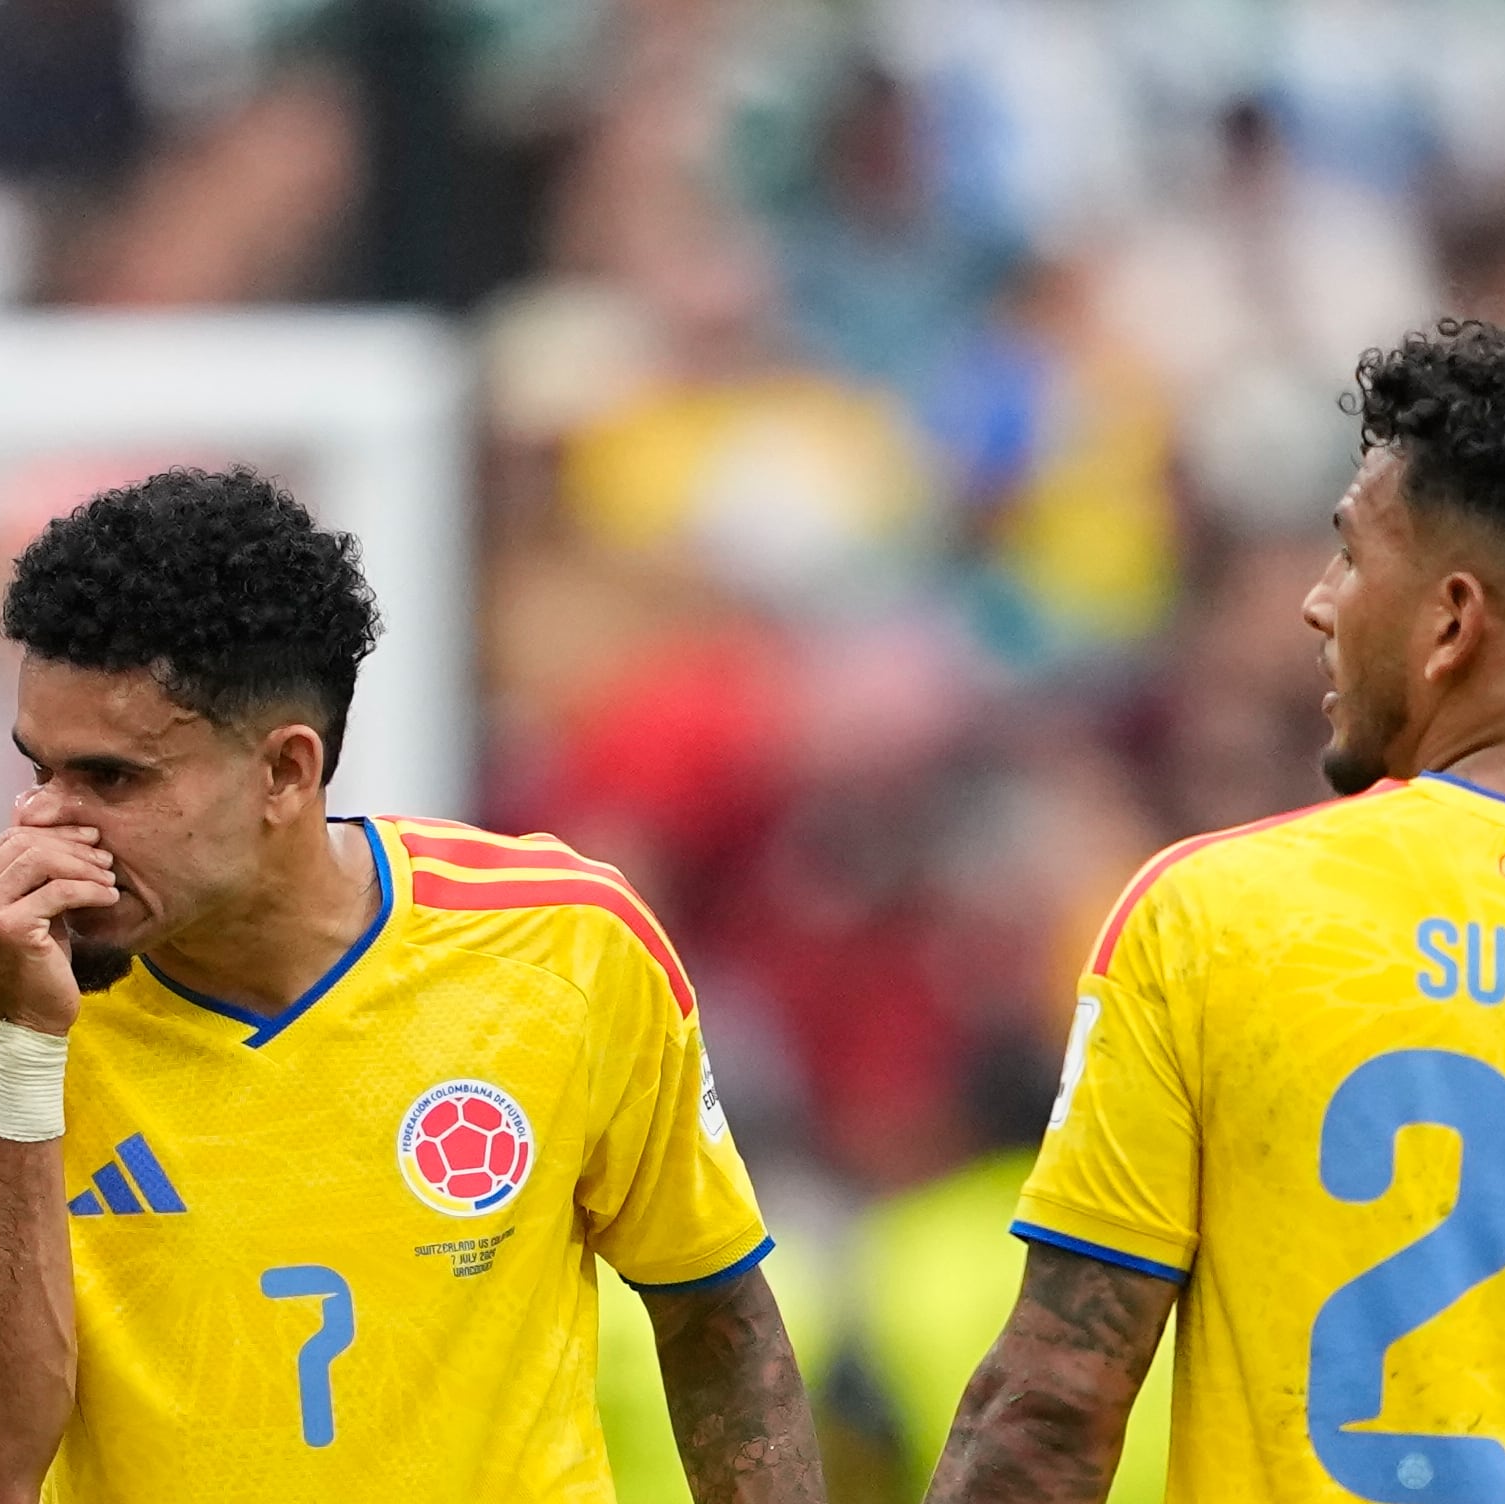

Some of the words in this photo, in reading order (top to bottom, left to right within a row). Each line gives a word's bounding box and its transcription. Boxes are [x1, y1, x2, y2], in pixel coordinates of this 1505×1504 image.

[430, 1083, 493, 1101] COLOMBIANA
[493, 1093, 506, 1107] DE
[414, 1239, 476, 1257] SWITZERLAND
[459, 1252, 478, 1265] JULY
[260, 1264, 356, 1448] 7
